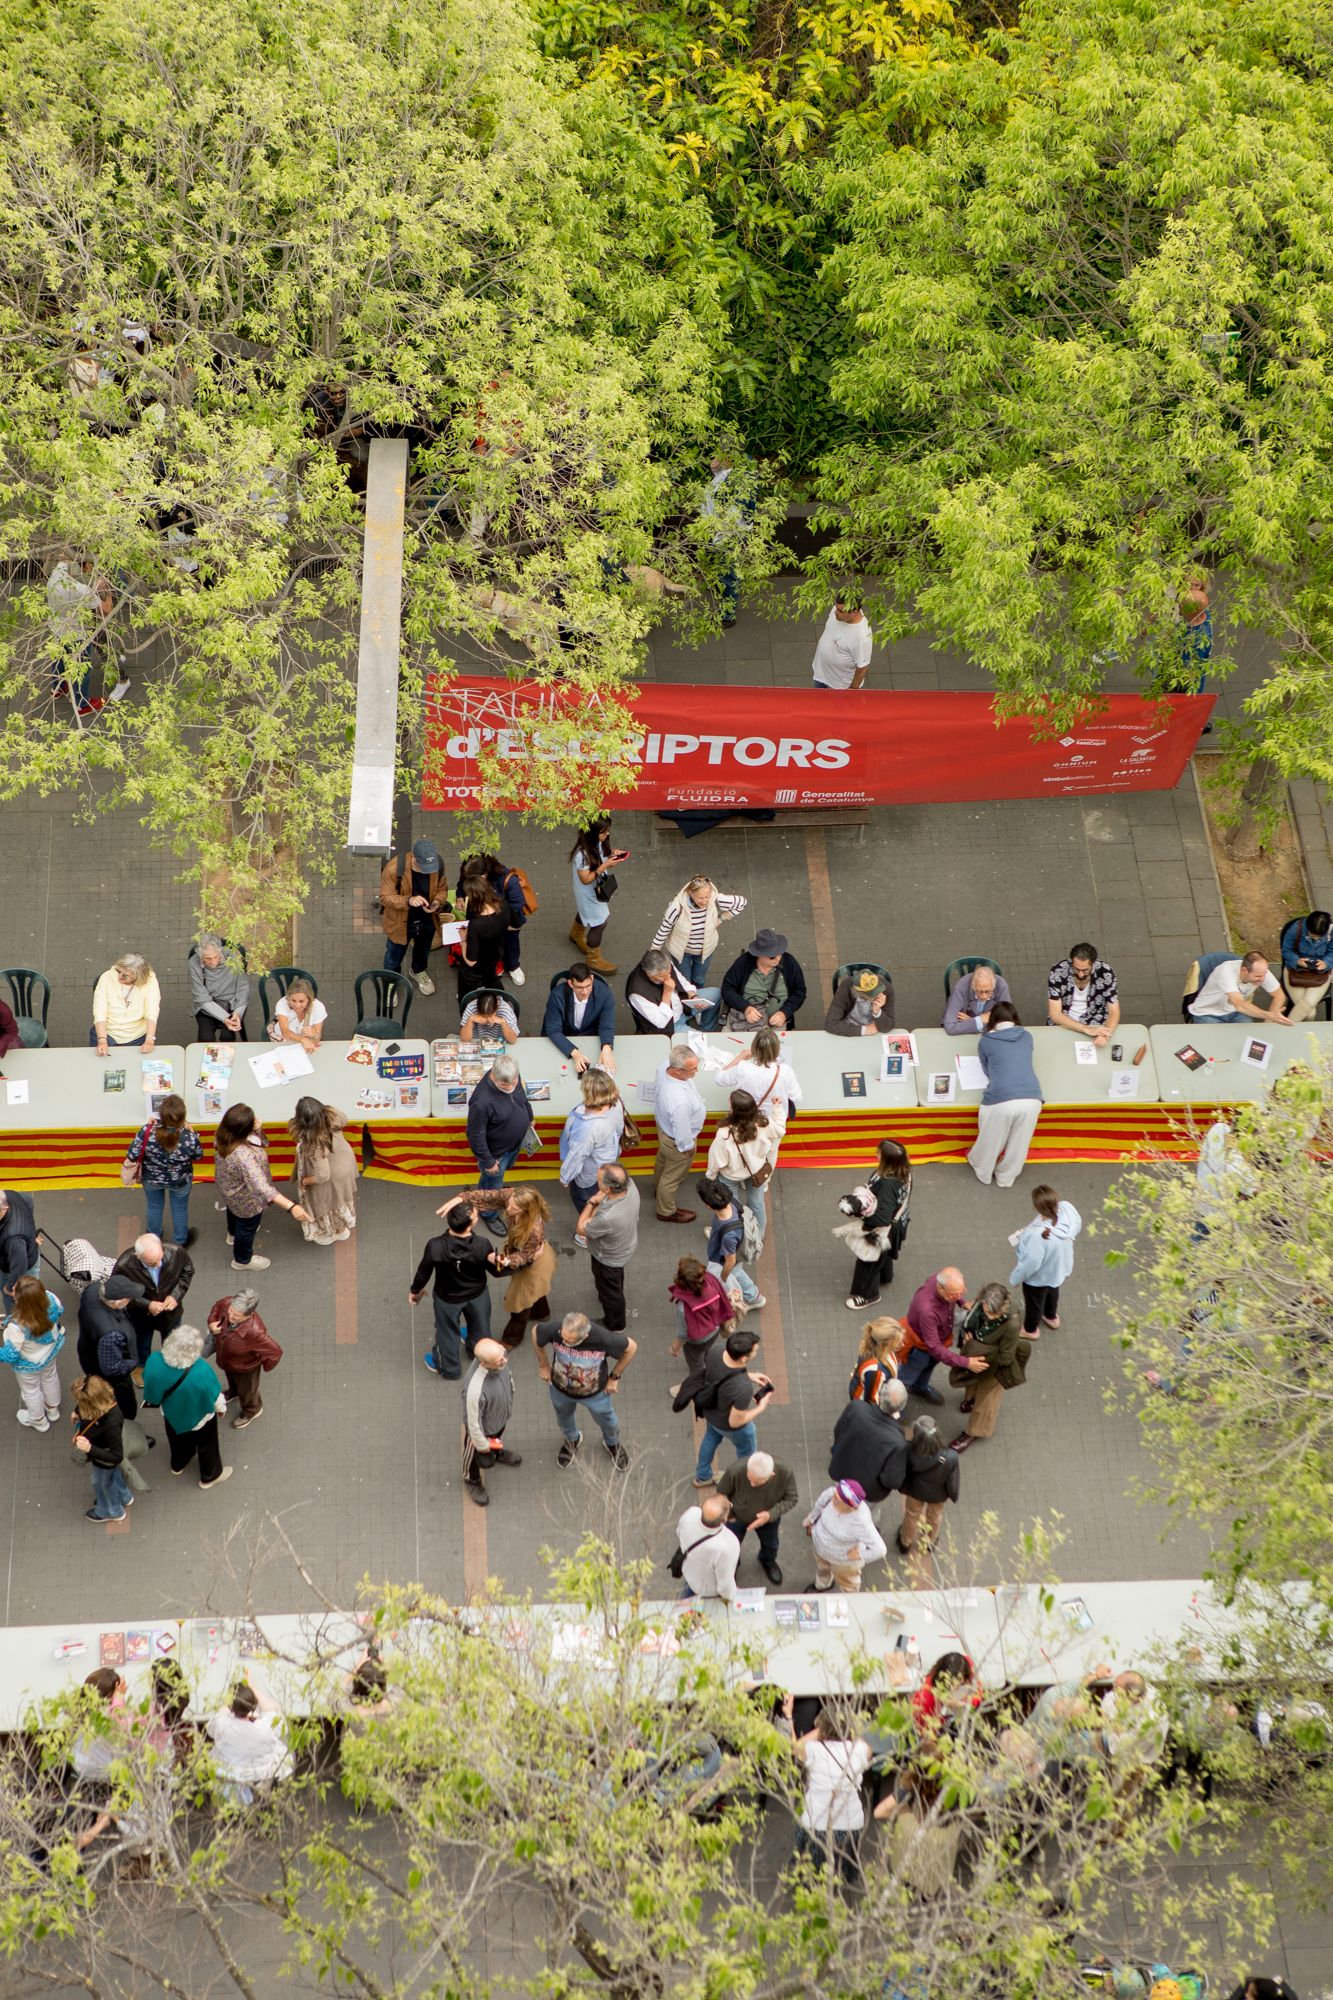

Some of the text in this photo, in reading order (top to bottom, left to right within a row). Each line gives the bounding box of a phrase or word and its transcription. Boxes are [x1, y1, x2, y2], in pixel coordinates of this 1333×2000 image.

[668, 787, 736, 795] Fundació
[667, 795, 749, 803] FLUIDRA
[812, 796, 874, 804] Catalunya
